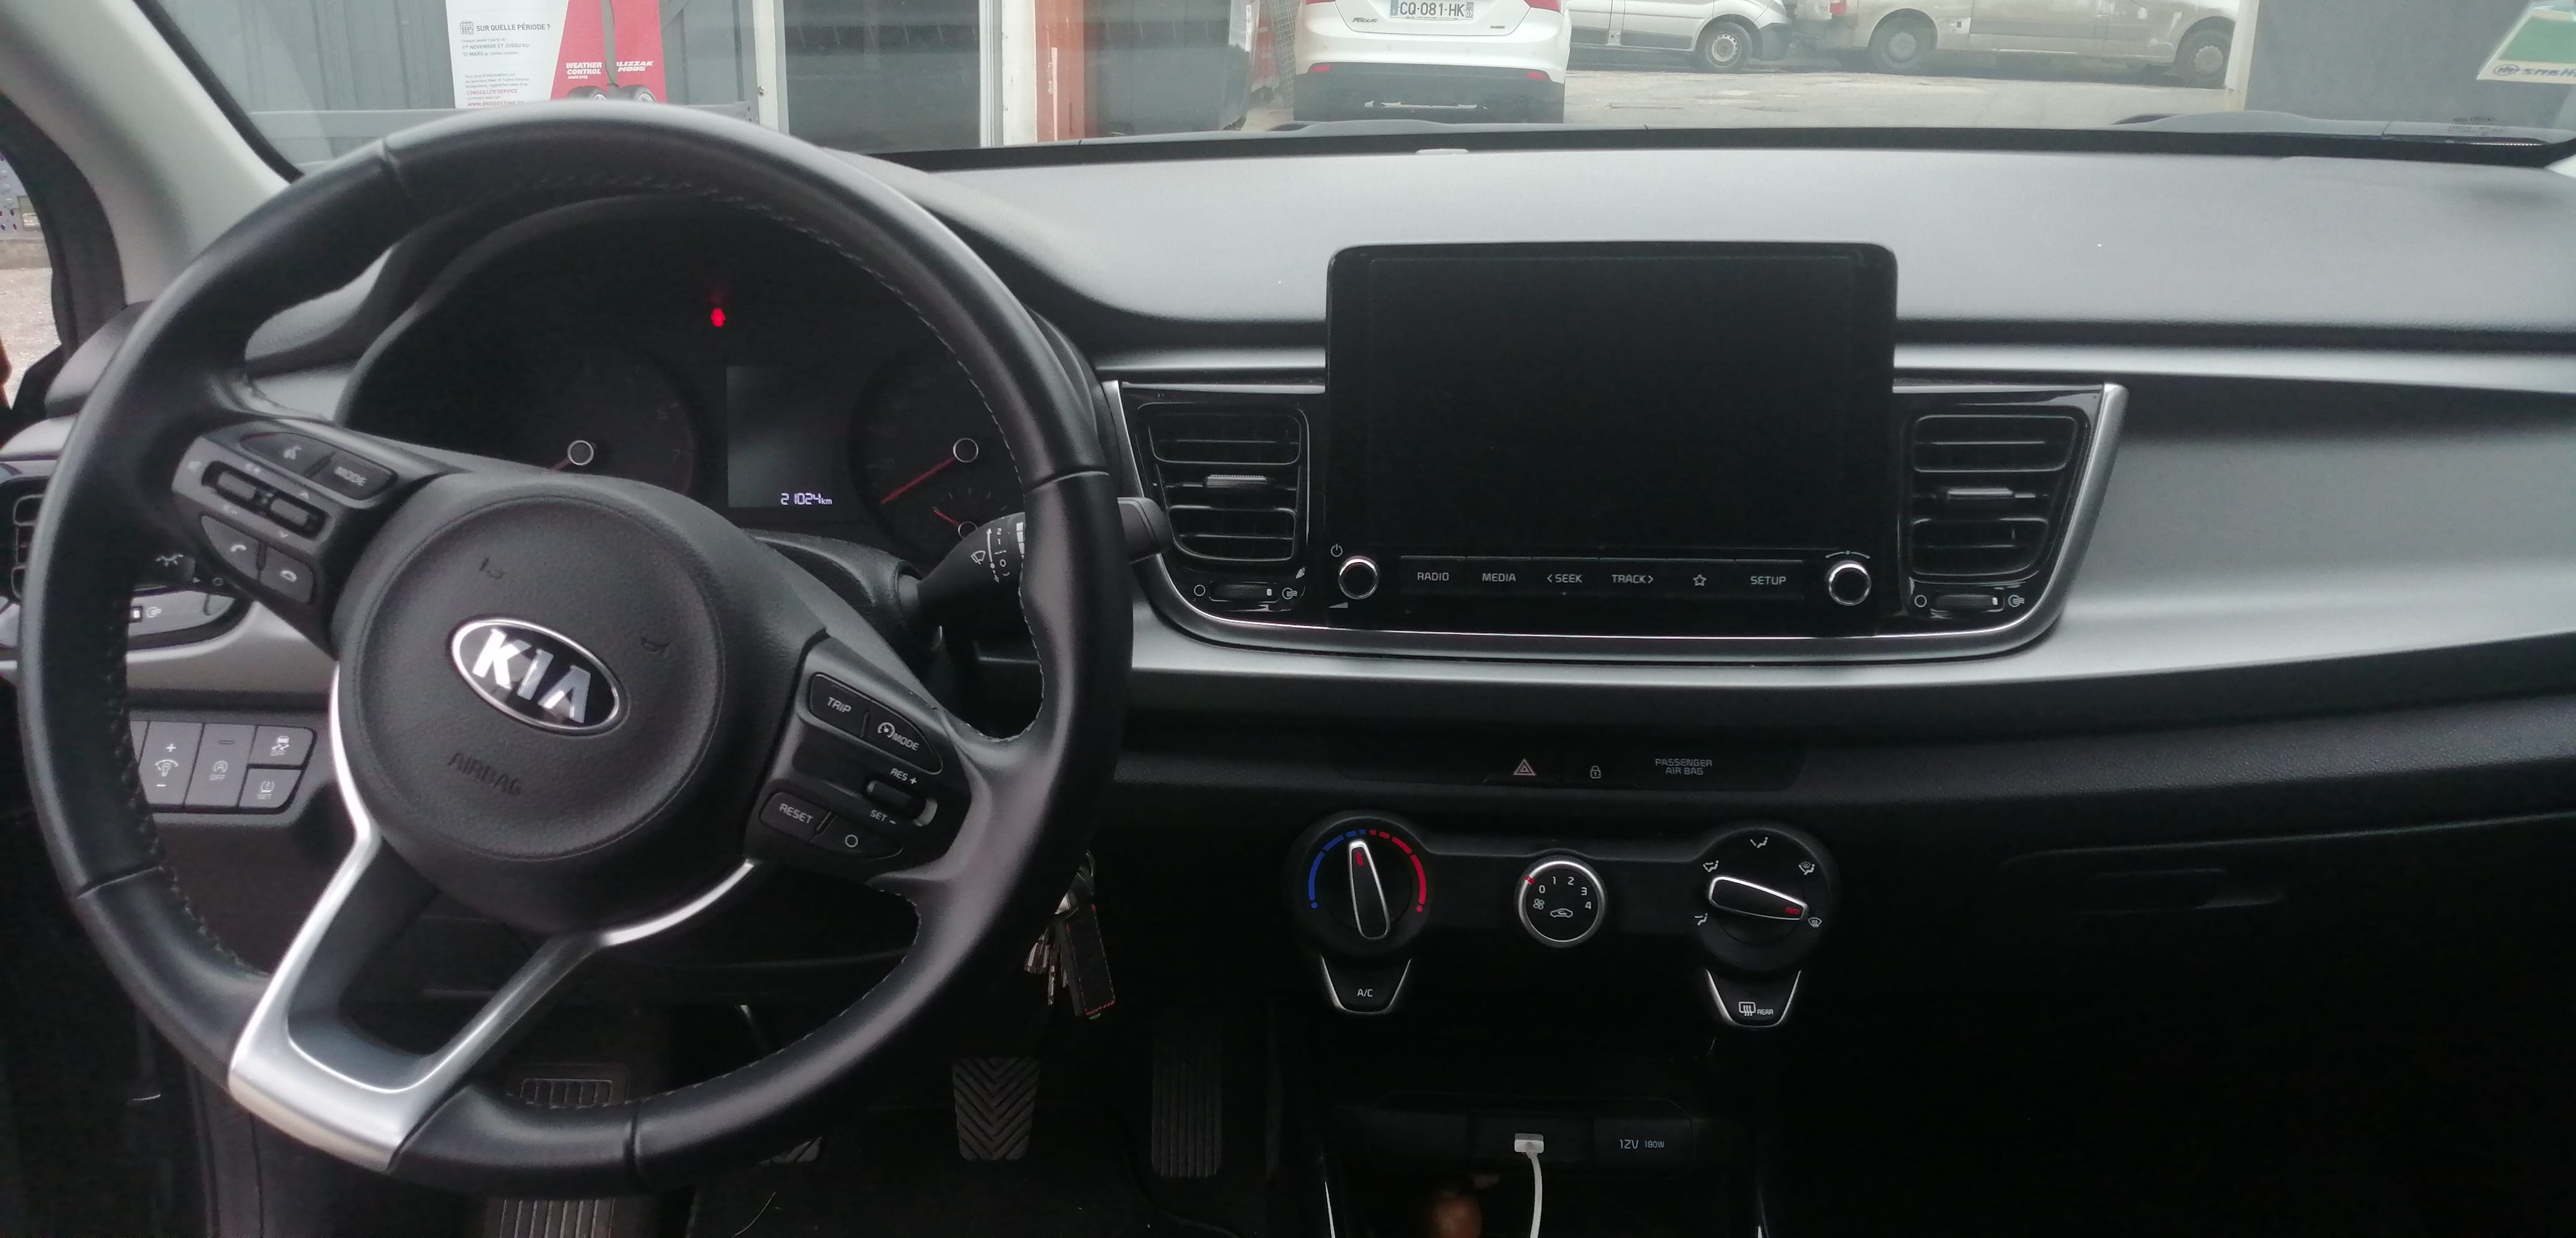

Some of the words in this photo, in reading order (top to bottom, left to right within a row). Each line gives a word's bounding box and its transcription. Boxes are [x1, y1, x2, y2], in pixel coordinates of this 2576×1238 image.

[517, 22, 546, 30] PÉRIODE
[334, 466, 367, 487] MODE
[1417, 572, 1450, 581] RADIO
[1482, 573, 1516, 582] MEDIA
[1750, 576, 1786, 585] SETUP
[472, 628, 591, 724] KIA
[827, 696, 852, 713] TRIP
[892, 733, 920, 751] MODE
[1655, 758, 1713, 767] PASSENGER
[447, 751, 522, 796] AIRBAG
[1665, 767, 1682, 775] AIR
[1684, 767, 1704, 776] BAG
[780, 803, 814, 825] RESET
[1552, 876, 1557, 885] 1
[1567, 876, 1575, 886] 2
[1580, 886, 1588, 896] 3
[1585, 901, 1592, 910] 4
[1357, 989, 1373, 997] A/C
[1619, 1139, 1639, 1149] 12V
